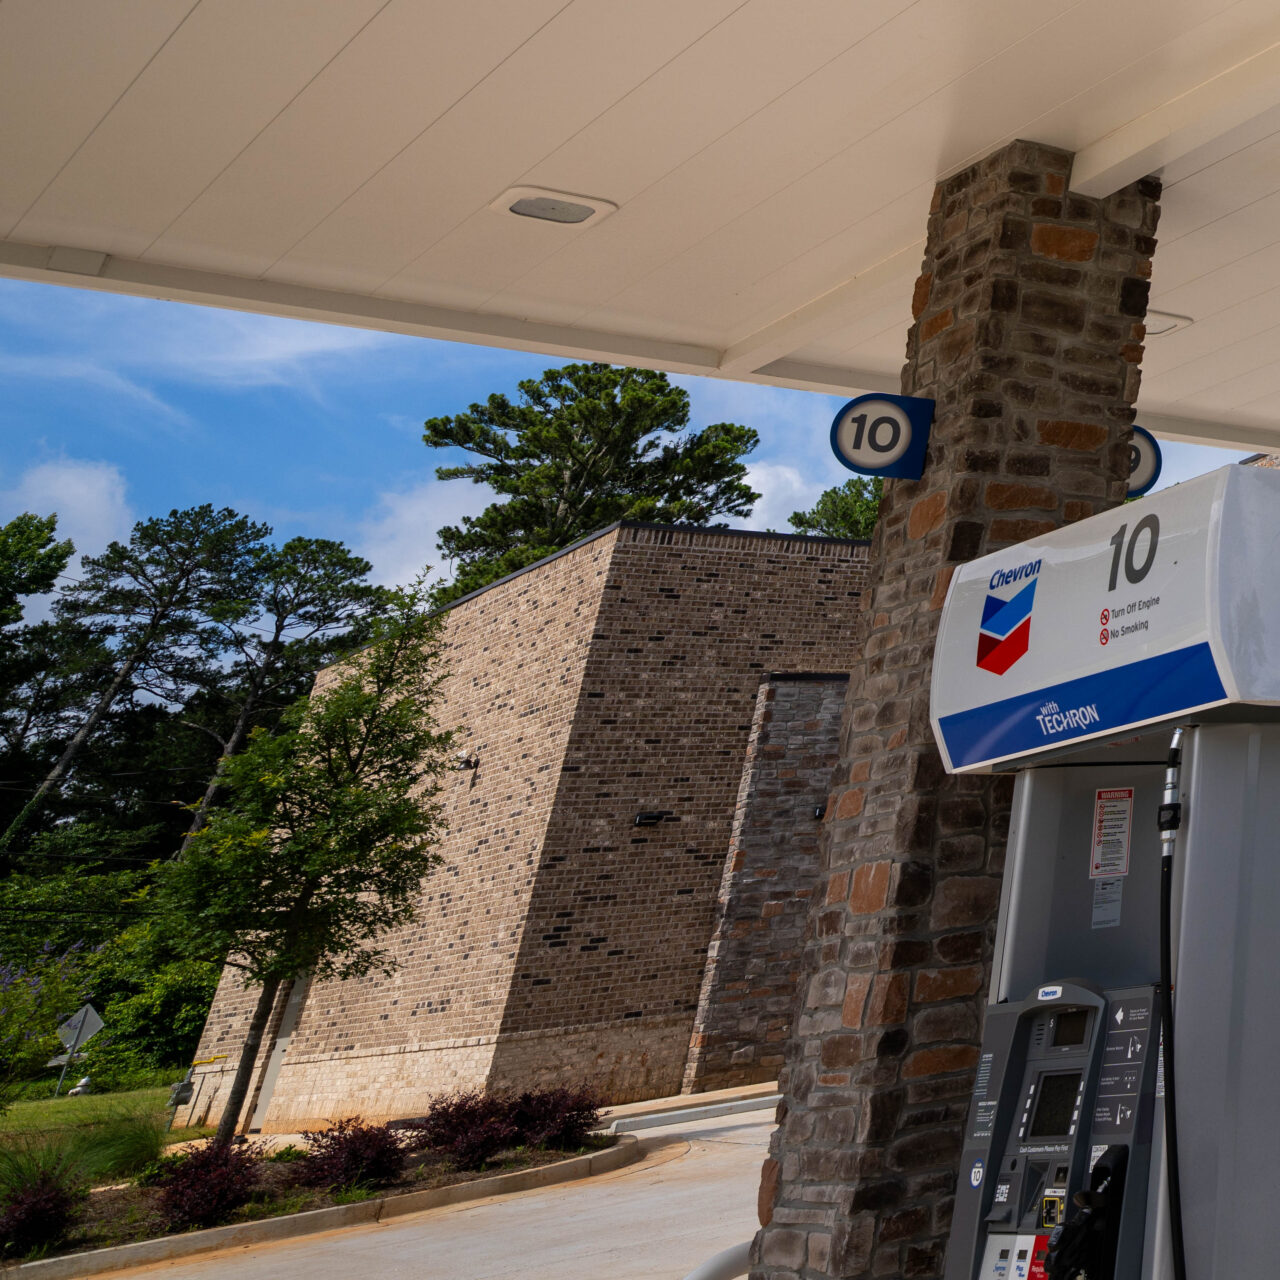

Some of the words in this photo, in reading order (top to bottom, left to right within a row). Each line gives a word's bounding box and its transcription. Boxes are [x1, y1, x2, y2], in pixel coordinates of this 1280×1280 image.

[851, 414, 901, 453] 10
[1107, 513, 1160, 592] 10
[989, 558, 1042, 590] Chevron
[1111, 608, 1125, 620] Turn
[1126, 603, 1137, 615] Off
[1138, 596, 1160, 612] Engine
[1110, 629, 1120, 639] No
[1121, 620, 1149, 636] Smoking
[1036, 703, 1100, 736] TECHRON
[1040, 701, 1059, 716] with
[1101, 790, 1129, 799] WARNING
[973, 1170, 981, 1182] 10
